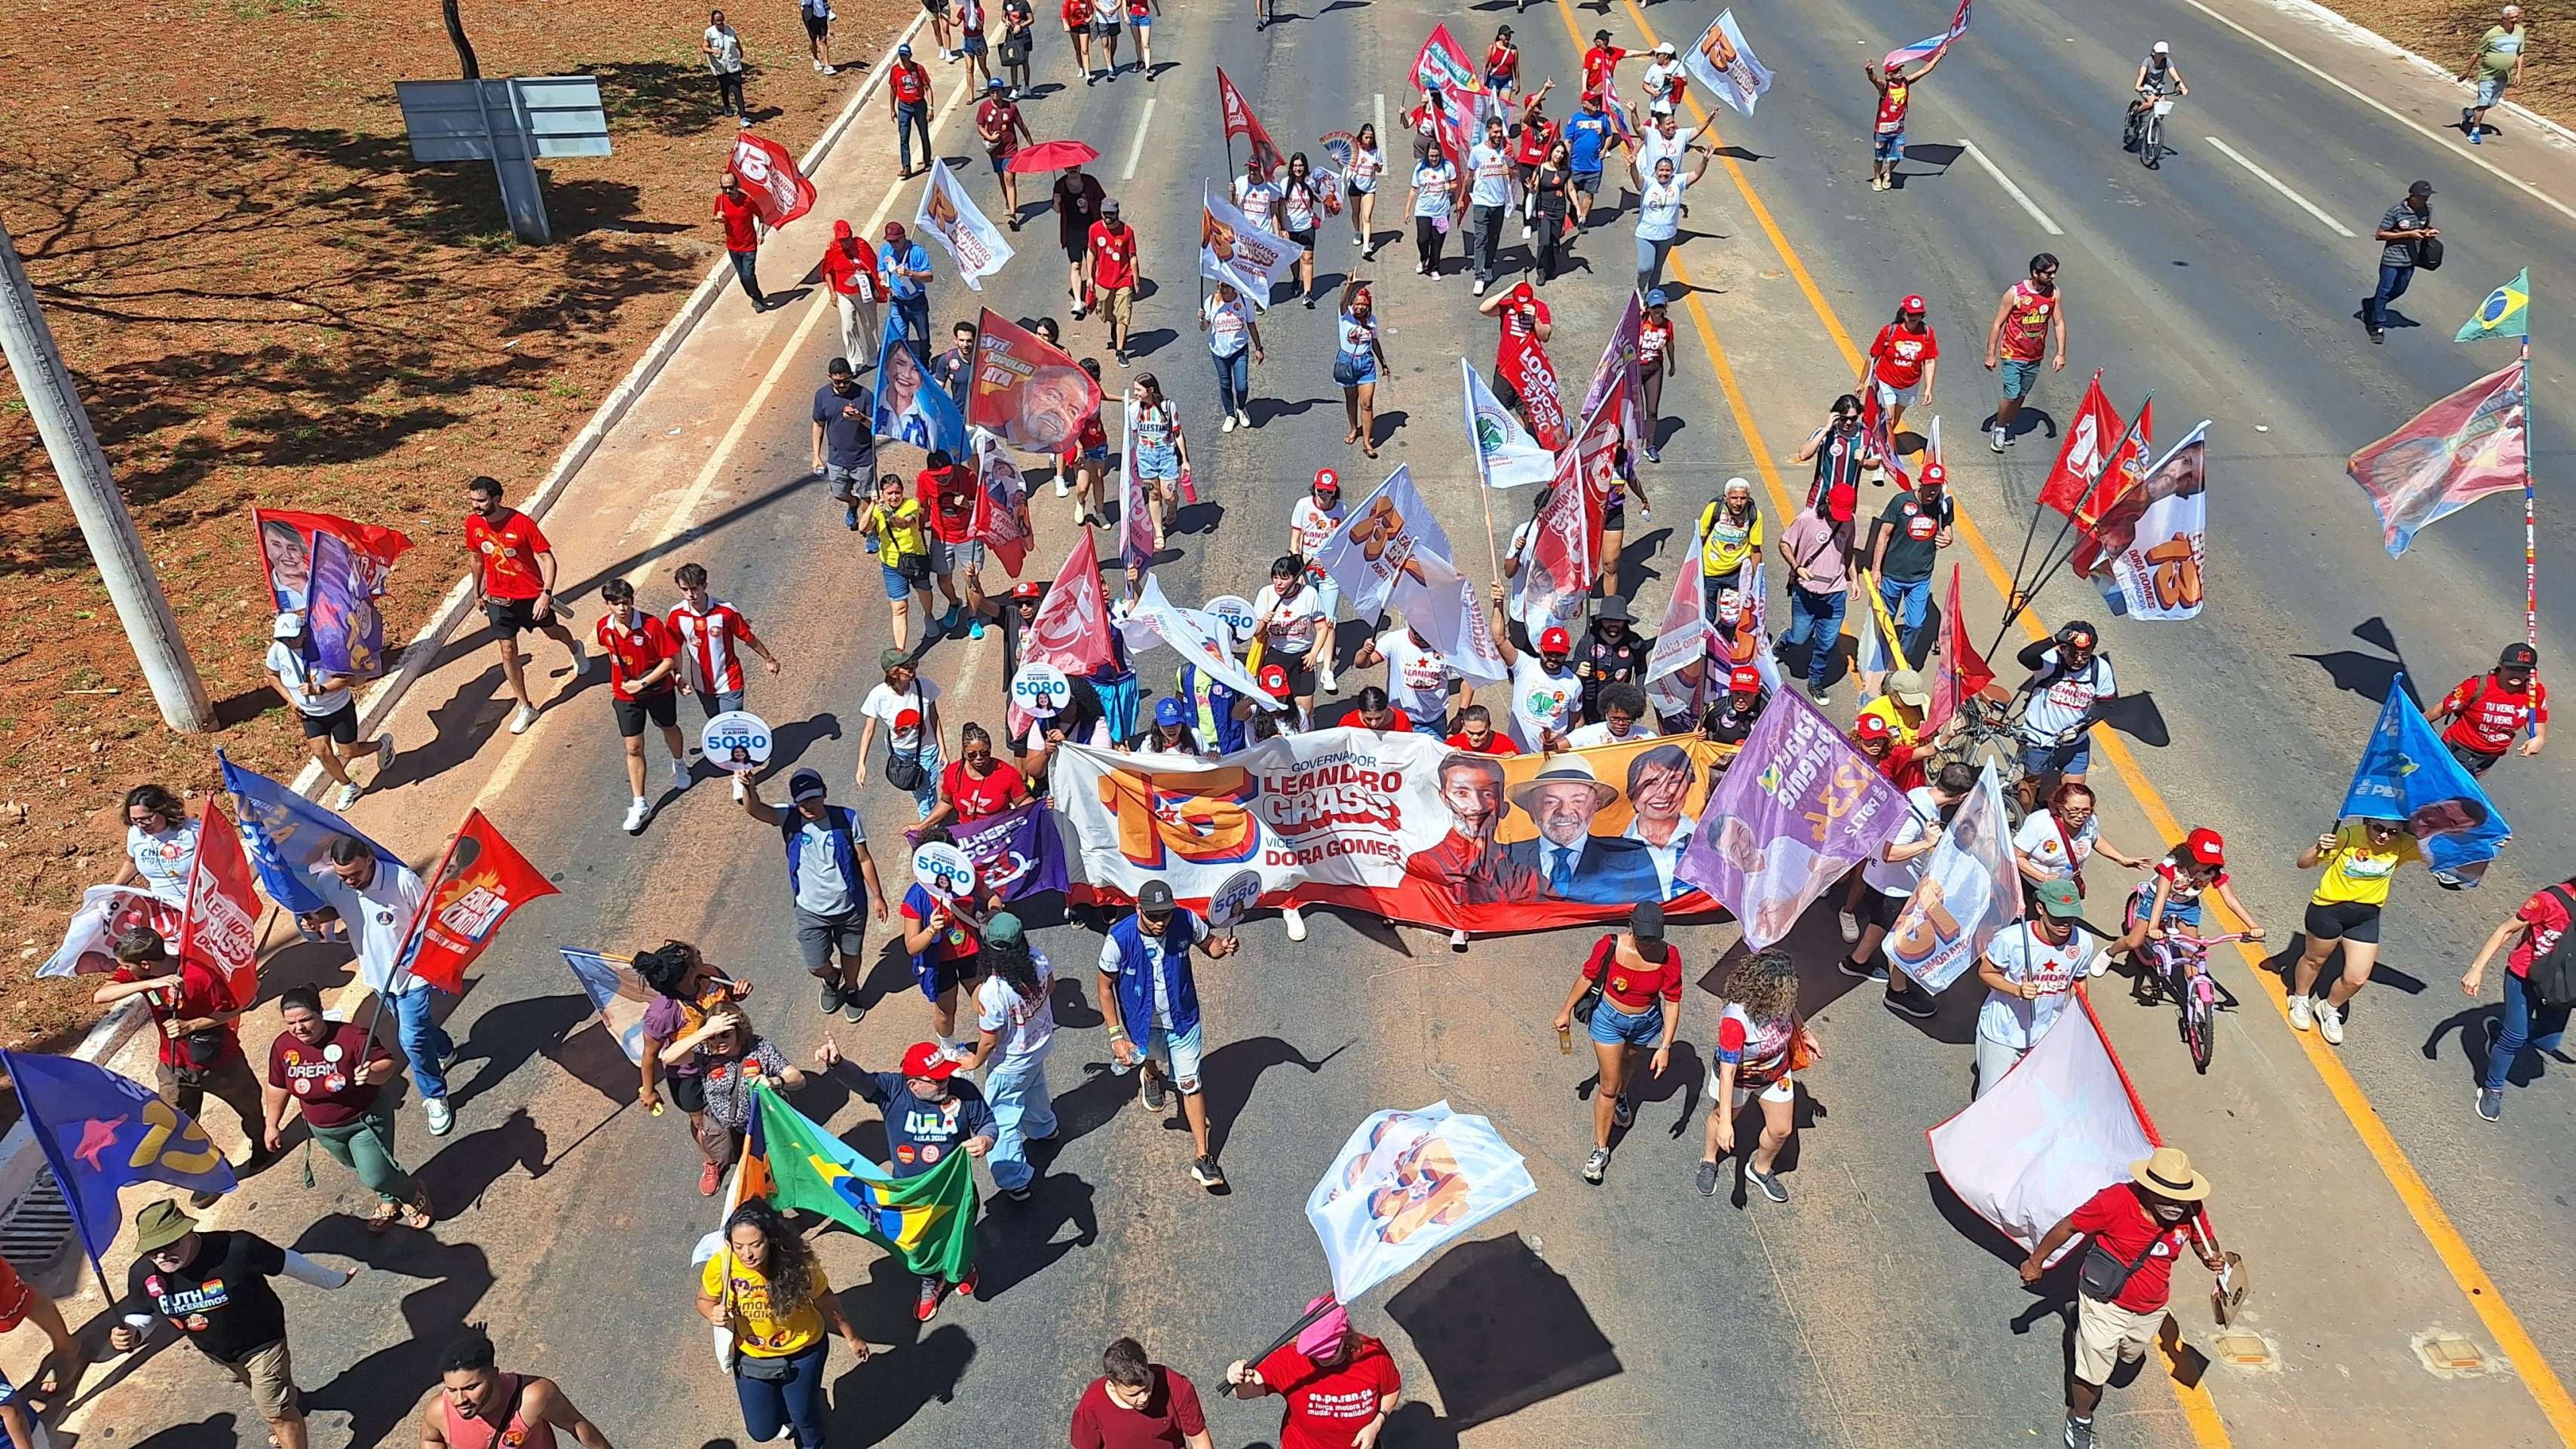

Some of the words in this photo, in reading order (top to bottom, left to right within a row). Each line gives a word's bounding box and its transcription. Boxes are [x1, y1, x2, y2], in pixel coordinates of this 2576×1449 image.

[1432, 42, 1471, 81] PRESIDENTE
[954, 220, 991, 261] LEANDRO
[1236, 231, 1279, 259] LEANDRO
[1526, 395, 1550, 433] Jacy
[2127, 549, 2143, 571] DORA
[2138, 570, 2156, 609] GOMES
[1269, 618, 1308, 627] LEANDRO
[1016, 682, 1065, 696] 5080
[2486, 702, 2495, 711] TU
[2483, 713, 2492, 723] TU
[2479, 724, 2488, 733] EU
[708, 736, 767, 750] 5080
[1292, 752, 1377, 773] GOVERNADOR
[1264, 764, 1403, 797] LEANDRO
[1263, 786, 1402, 835] GRASS
[1266, 837, 1294, 849] VICE
[1266, 846, 1325, 866] DORA
[1326, 838, 1401, 862] GOMES
[917, 856, 970, 884] 5080
[932, 856, 957, 867] KARINE
[1214, 881, 1259, 913] 5080
[1227, 883, 1248, 895] KARINE
[287, 1063, 338, 1078] DREAM
[905, 1110, 959, 1135] LULA
[158, 1290, 203, 1309] RUTH
[1316, 1403, 1334, 1411] força
[1335, 1403, 1361, 1411] motora
